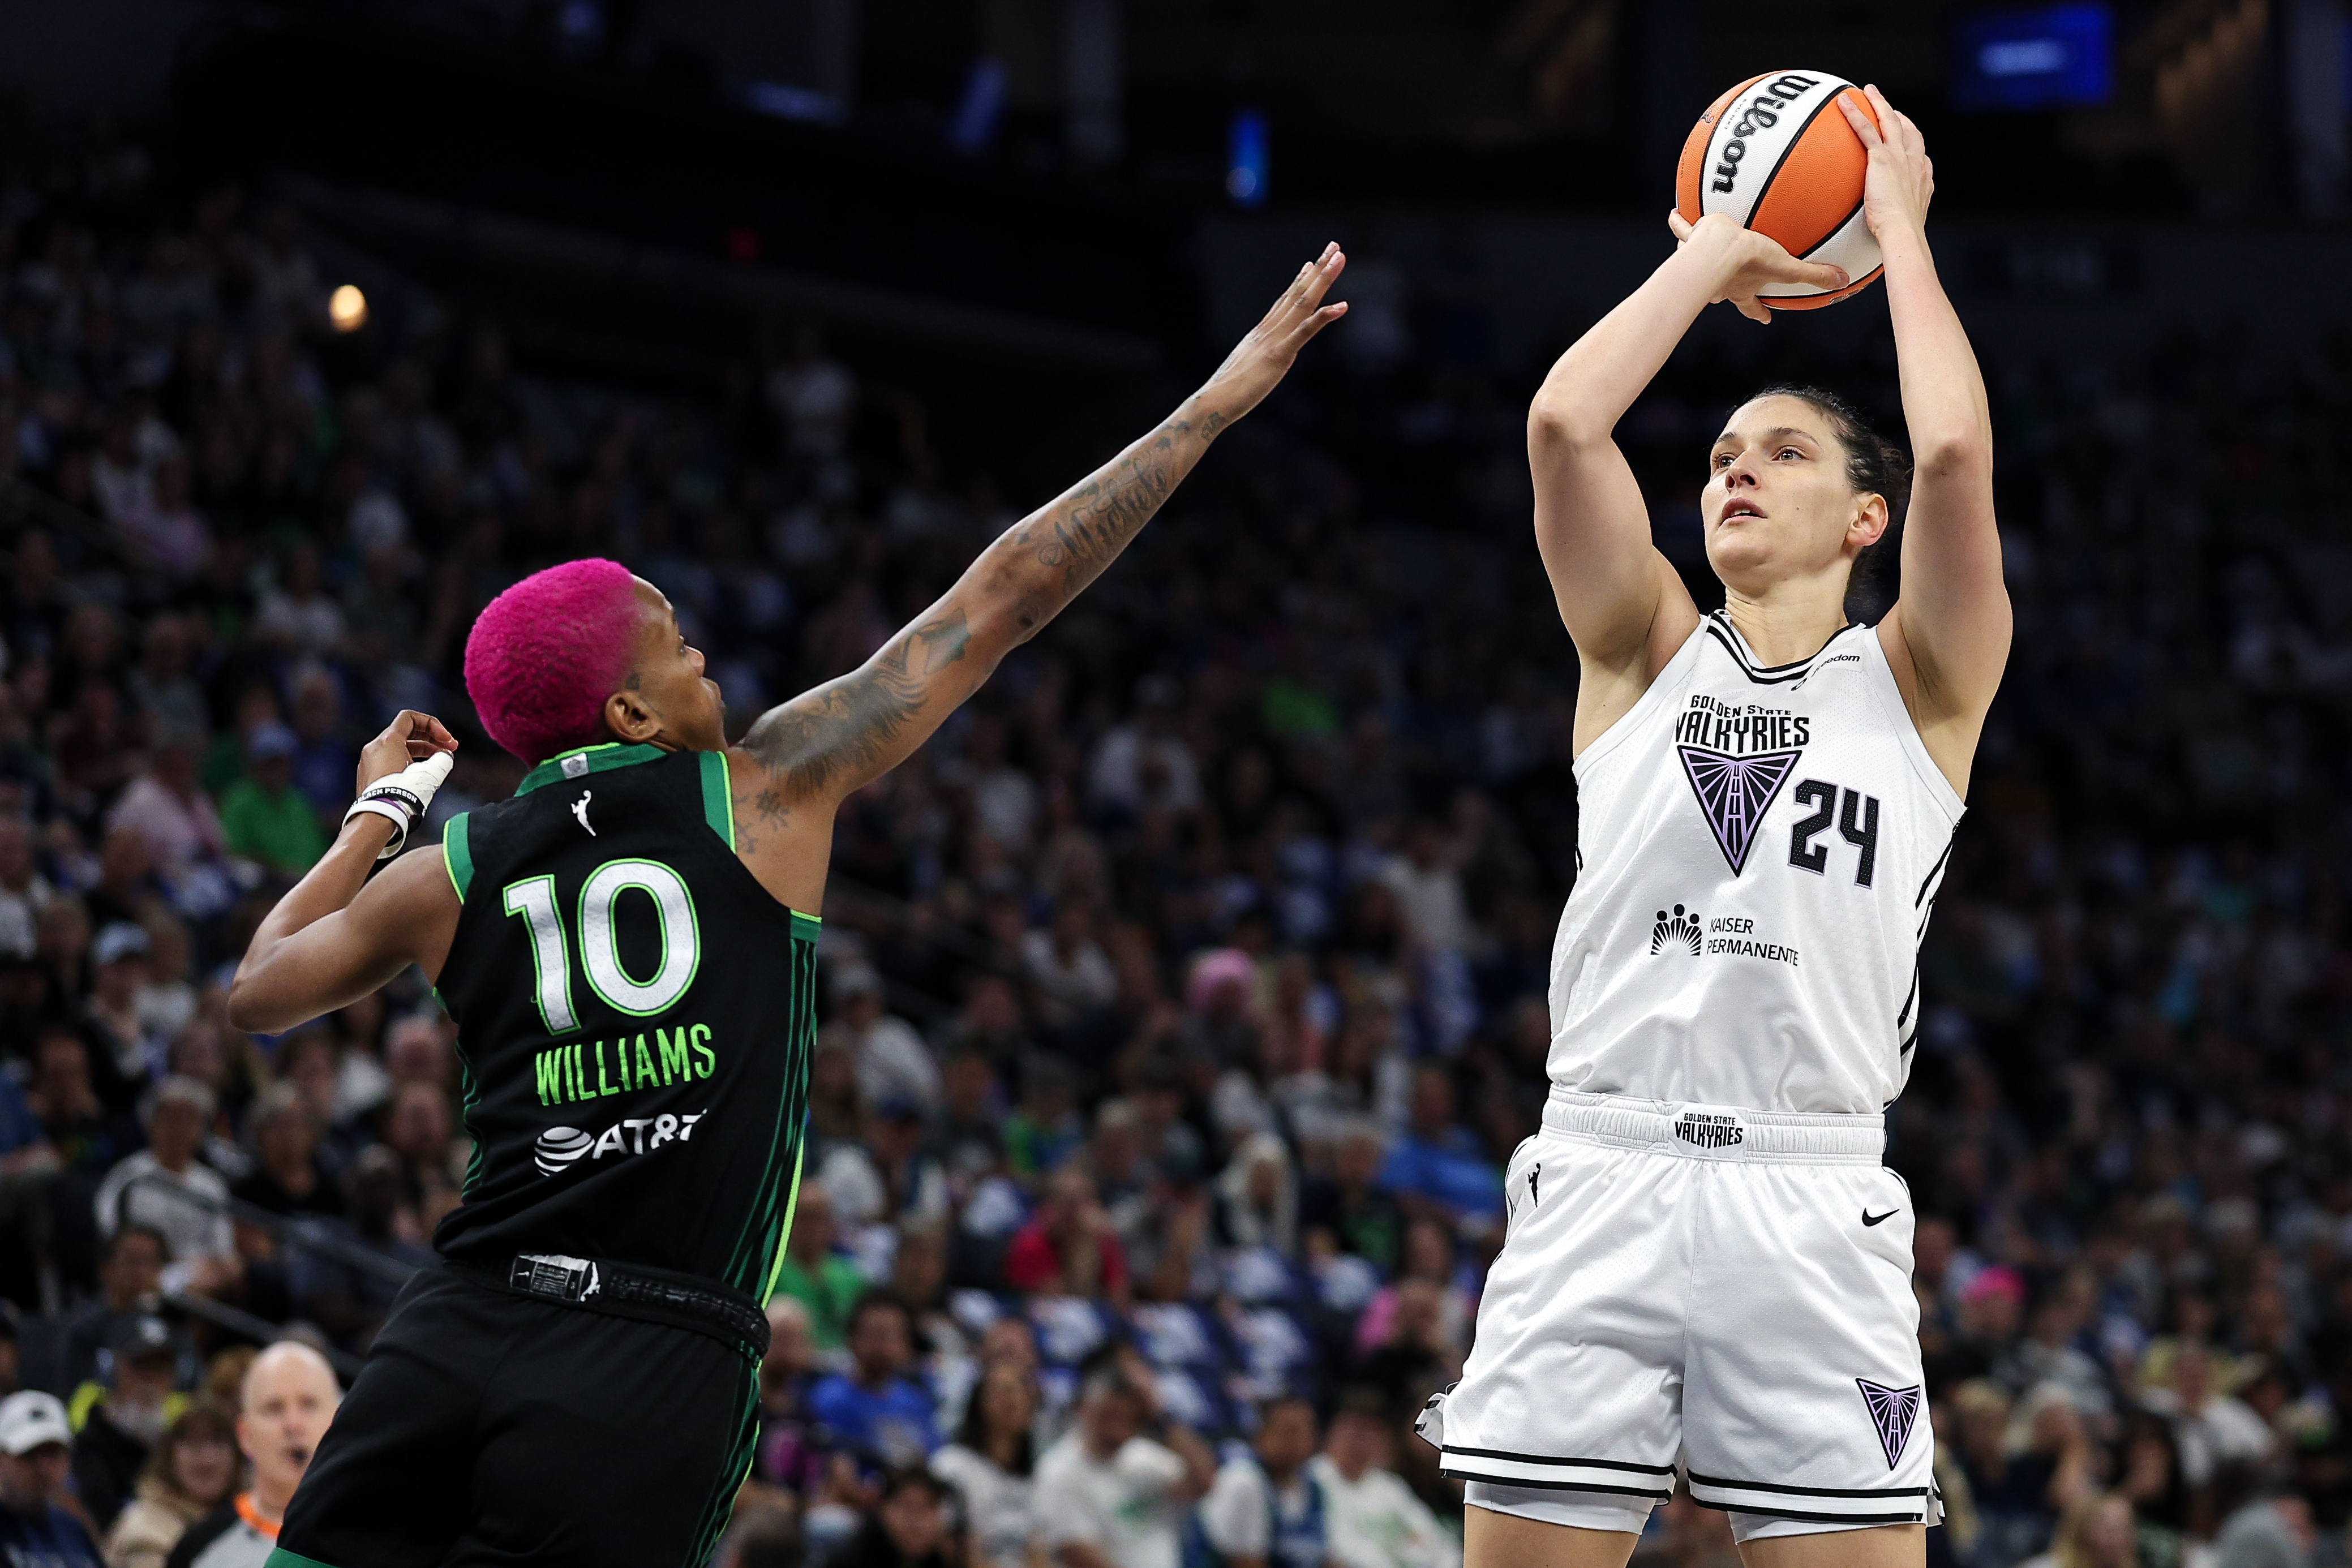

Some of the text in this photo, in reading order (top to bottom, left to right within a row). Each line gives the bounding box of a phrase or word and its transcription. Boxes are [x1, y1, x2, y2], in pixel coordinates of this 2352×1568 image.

[1711, 75, 1821, 194] Wilson
[1724, 115, 1735, 130] NXT
[1690, 695, 1792, 718] GOLDEN STATE
[1675, 711, 1809, 754] VALKYRIES
[385, 788, 417, 804] PERSON
[1788, 778, 1880, 890] 24
[1709, 917, 1754, 934] KAISER
[503, 858, 701, 1036] 10
[1707, 938, 1799, 966] PERMANENTE
[535, 1024, 716, 1106] WILLIAMS
[1684, 1112, 1736, 1125] GOLDEN STATE
[592, 1108, 707, 1159] AT&T
[1675, 1122, 1743, 1149] VALKYRIES
